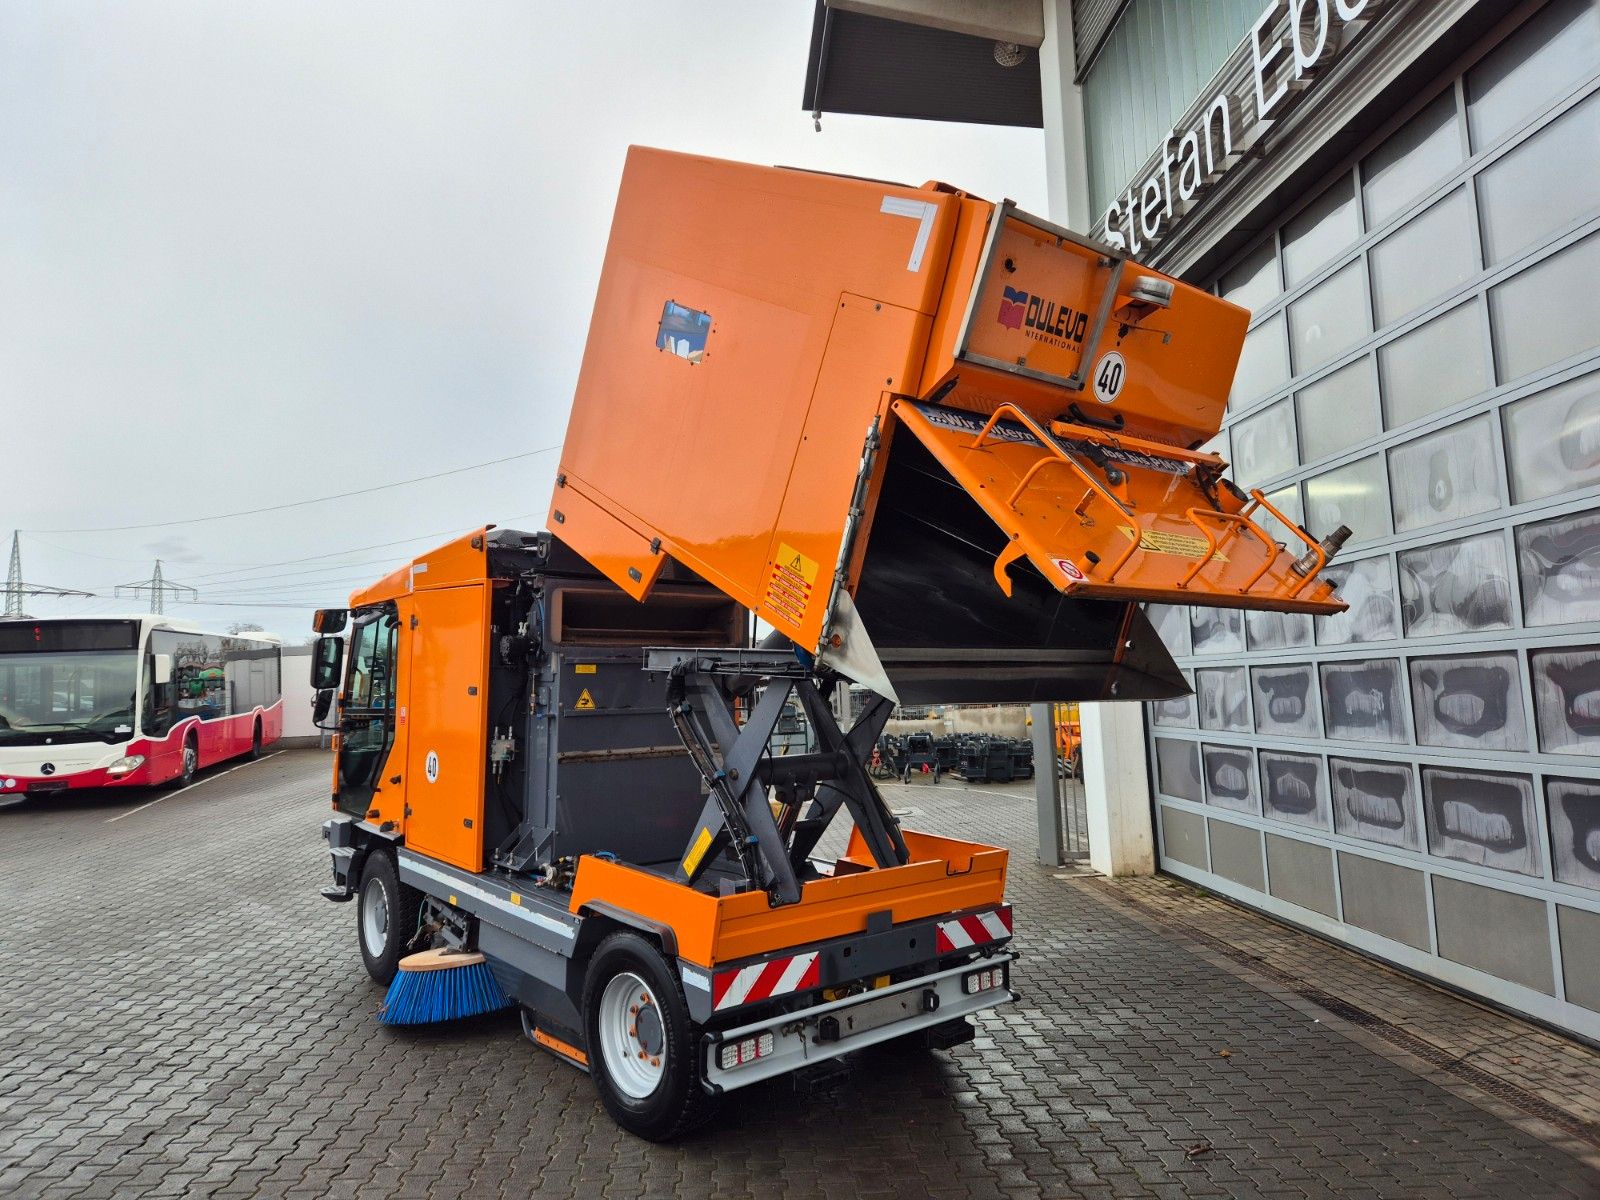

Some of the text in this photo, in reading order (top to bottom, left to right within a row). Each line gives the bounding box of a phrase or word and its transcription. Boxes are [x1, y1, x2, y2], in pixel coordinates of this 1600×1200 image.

[1105, 94, 1232, 256] Stefan
[1025, 295, 1088, 343] DULEVO
[1098, 360, 1122, 395] 40
[428, 756, 436, 777] 40
